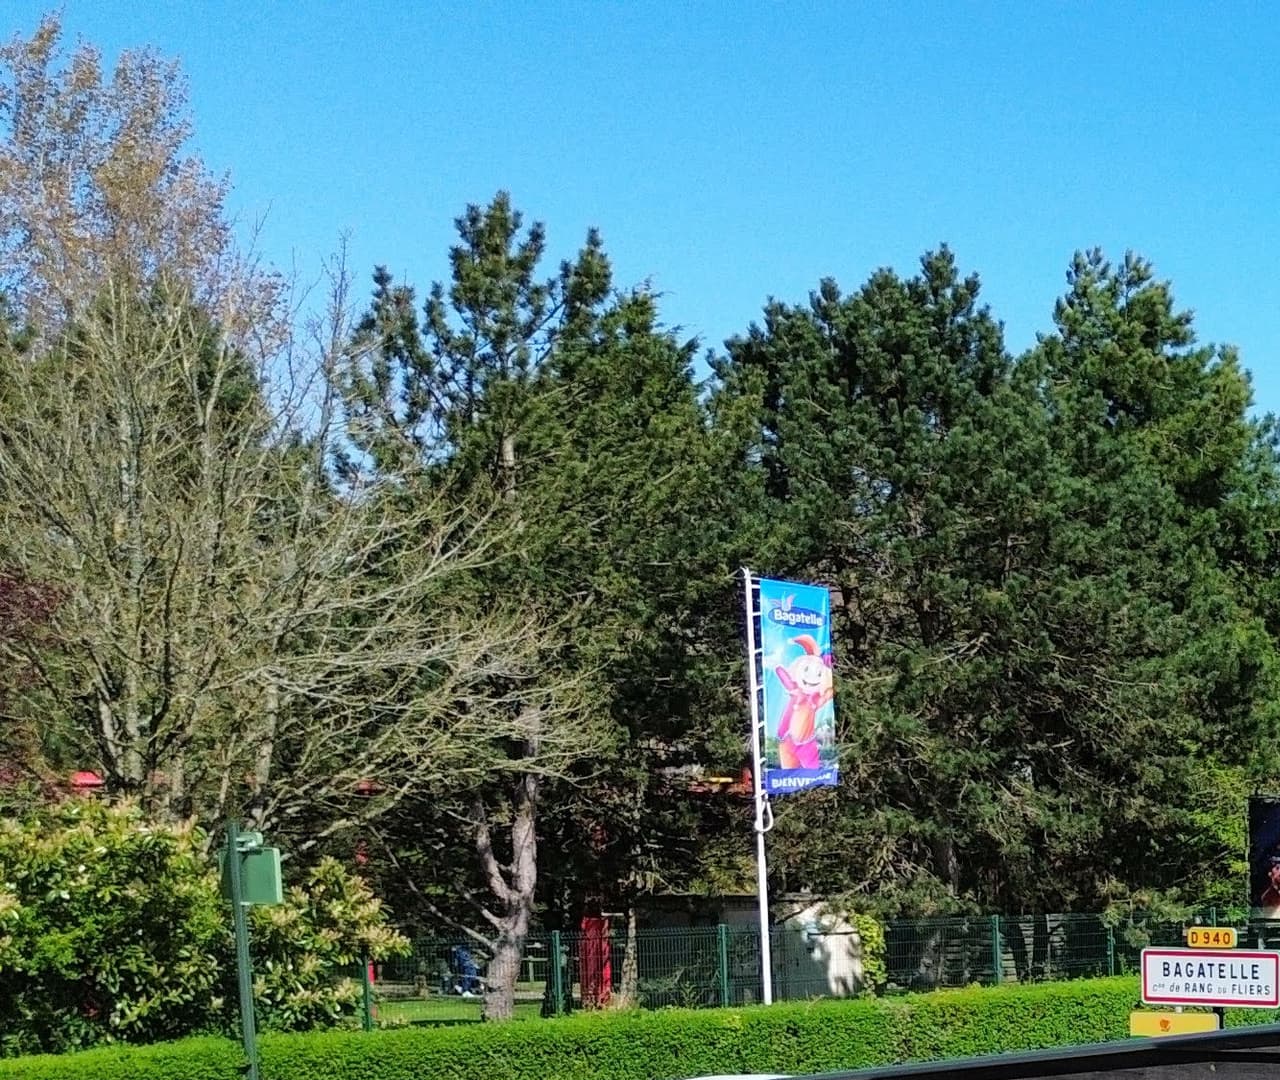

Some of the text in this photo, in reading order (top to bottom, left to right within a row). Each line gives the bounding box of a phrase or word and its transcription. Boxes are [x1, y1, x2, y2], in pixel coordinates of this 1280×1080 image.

[773, 609, 823, 626] Bagatelle
[1191, 932, 1231, 945] D 940
[1162, 961, 1260, 980] BAGATELLE
[1169, 983, 1180, 992] de
[1184, 983, 1213, 993] RANG
[1231, 984, 1271, 996] FLIERS
